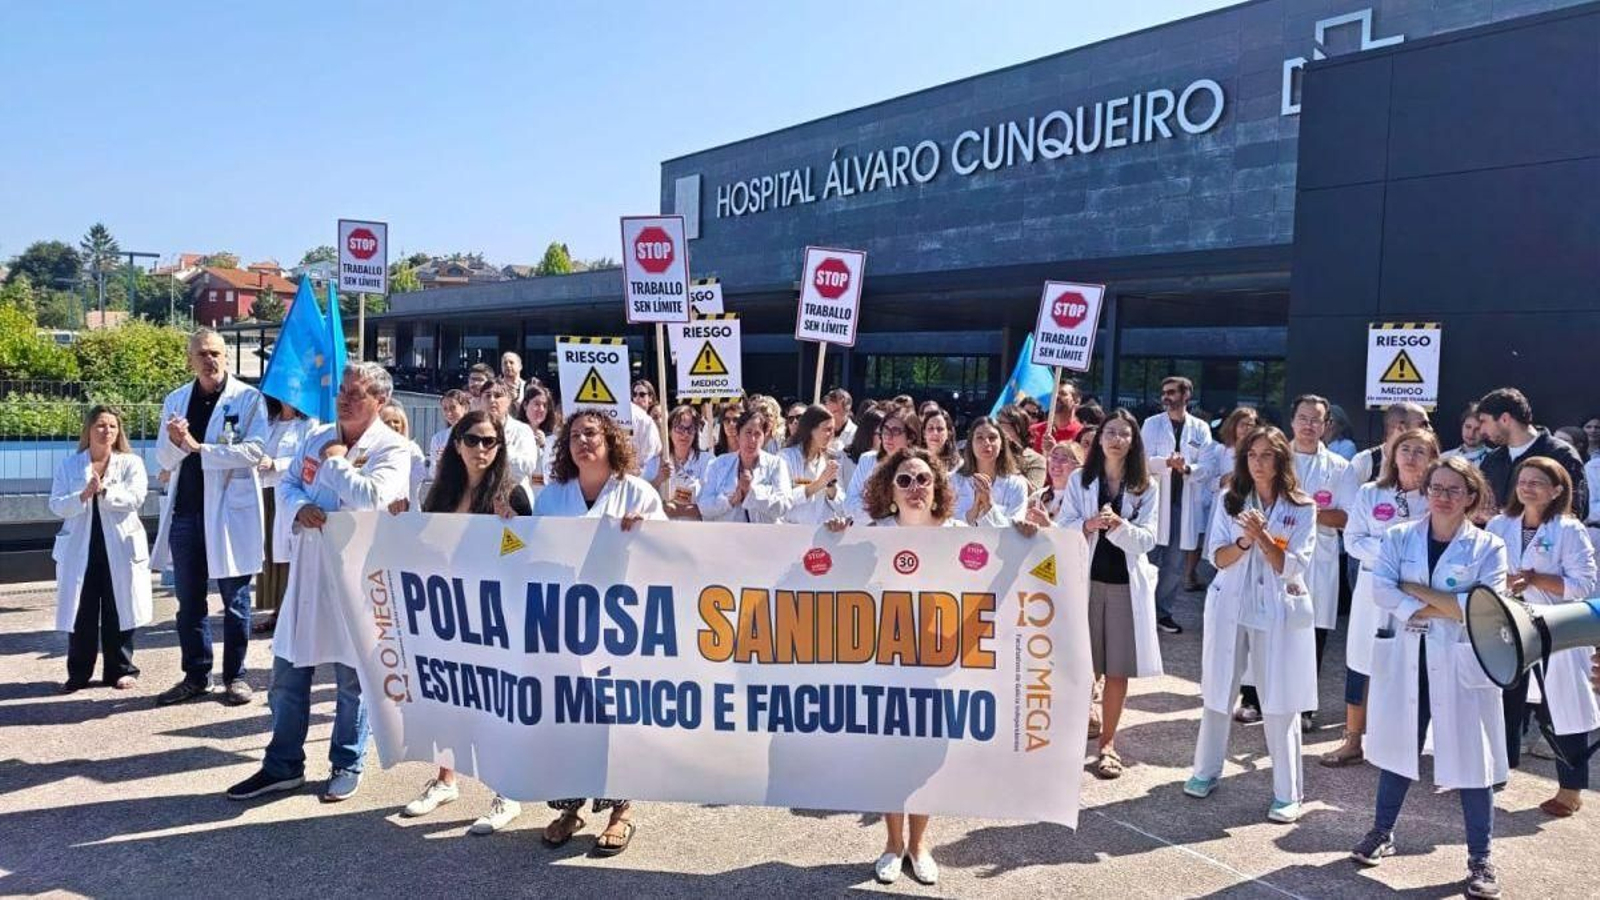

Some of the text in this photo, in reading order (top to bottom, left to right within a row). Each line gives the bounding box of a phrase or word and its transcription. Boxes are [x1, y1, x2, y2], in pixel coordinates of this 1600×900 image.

[717, 79, 1225, 218] HOSPITAL ÁLVARO CUNQUEIRO
[349, 237, 376, 252] STOP
[637, 242, 671, 259] STOP
[343, 263, 382, 276] TRABALLO
[816, 270, 848, 288] STOP
[631, 281, 683, 296] TRABALLO
[634, 297, 683, 313] SEN LÍMITE
[805, 303, 852, 320] TRABALLO
[1053, 302, 1086, 318] STOP
[683, 326, 732, 338] RIESGO
[804, 319, 849, 336] SEN LÍMITE
[1041, 332, 1088, 348] TRABALLO
[1376, 335, 1431, 347] RIESGO
[565, 351, 619, 364] RIESGO
[1039, 346, 1084, 361] SEN LÍMITE
[899, 556, 914, 567] 30
[401, 571, 509, 650] POLA
[524, 582, 679, 657] NOSA
[697, 585, 996, 670] SANIDADE
[415, 655, 996, 742] ESTATUTO MÉDICO E FACULTATIVO
